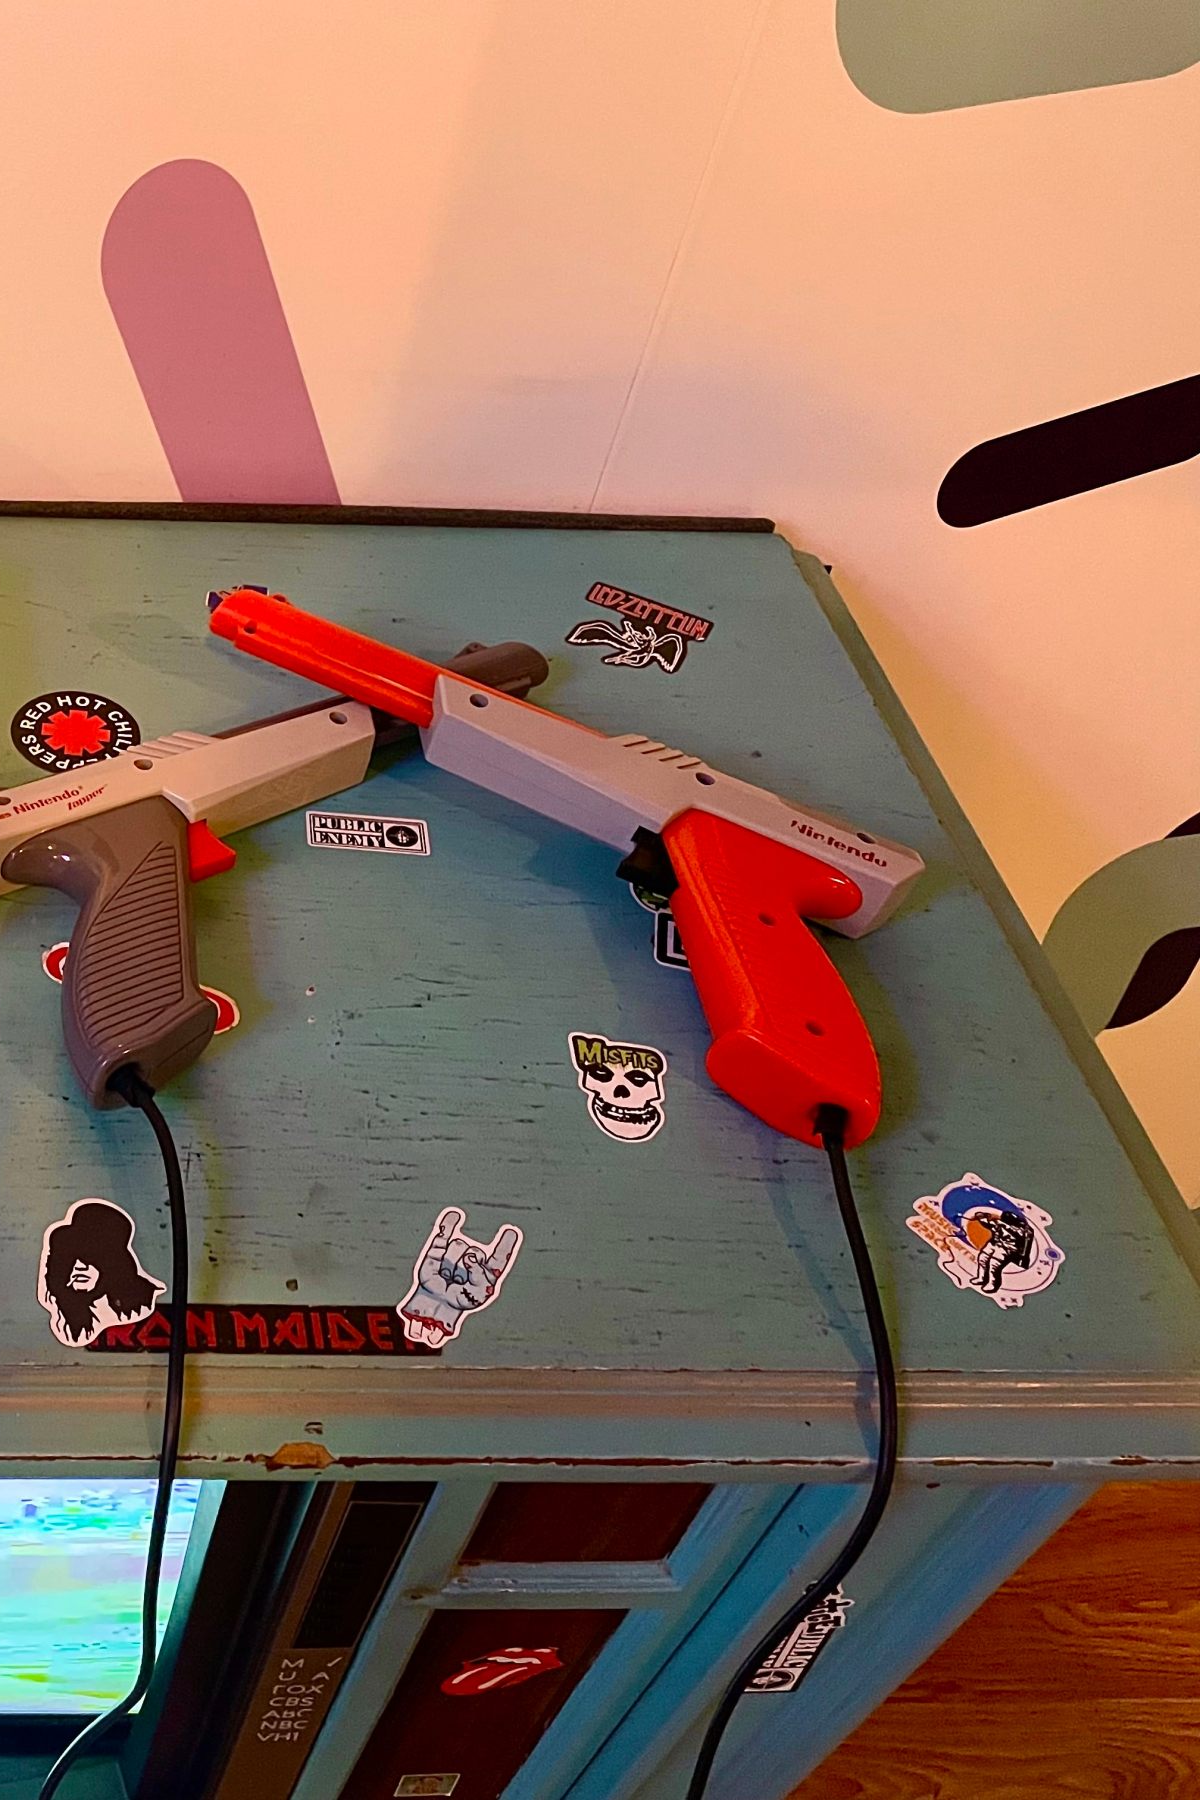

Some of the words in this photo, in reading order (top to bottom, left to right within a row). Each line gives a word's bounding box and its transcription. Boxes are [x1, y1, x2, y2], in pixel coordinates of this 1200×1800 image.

[20, 701, 52, 730] RED
[56, 695, 107, 711] HOT
[12, 789, 81, 814] Nintendo
[314, 816, 382, 833] PUBLIC
[314, 831, 382, 848] ENEMY
[790, 820, 887, 867] Nintendo
[230, 1310, 415, 1350] MAIDE
[269, 1697, 314, 1706] CBS
[260, 1720, 309, 1730] NBC
